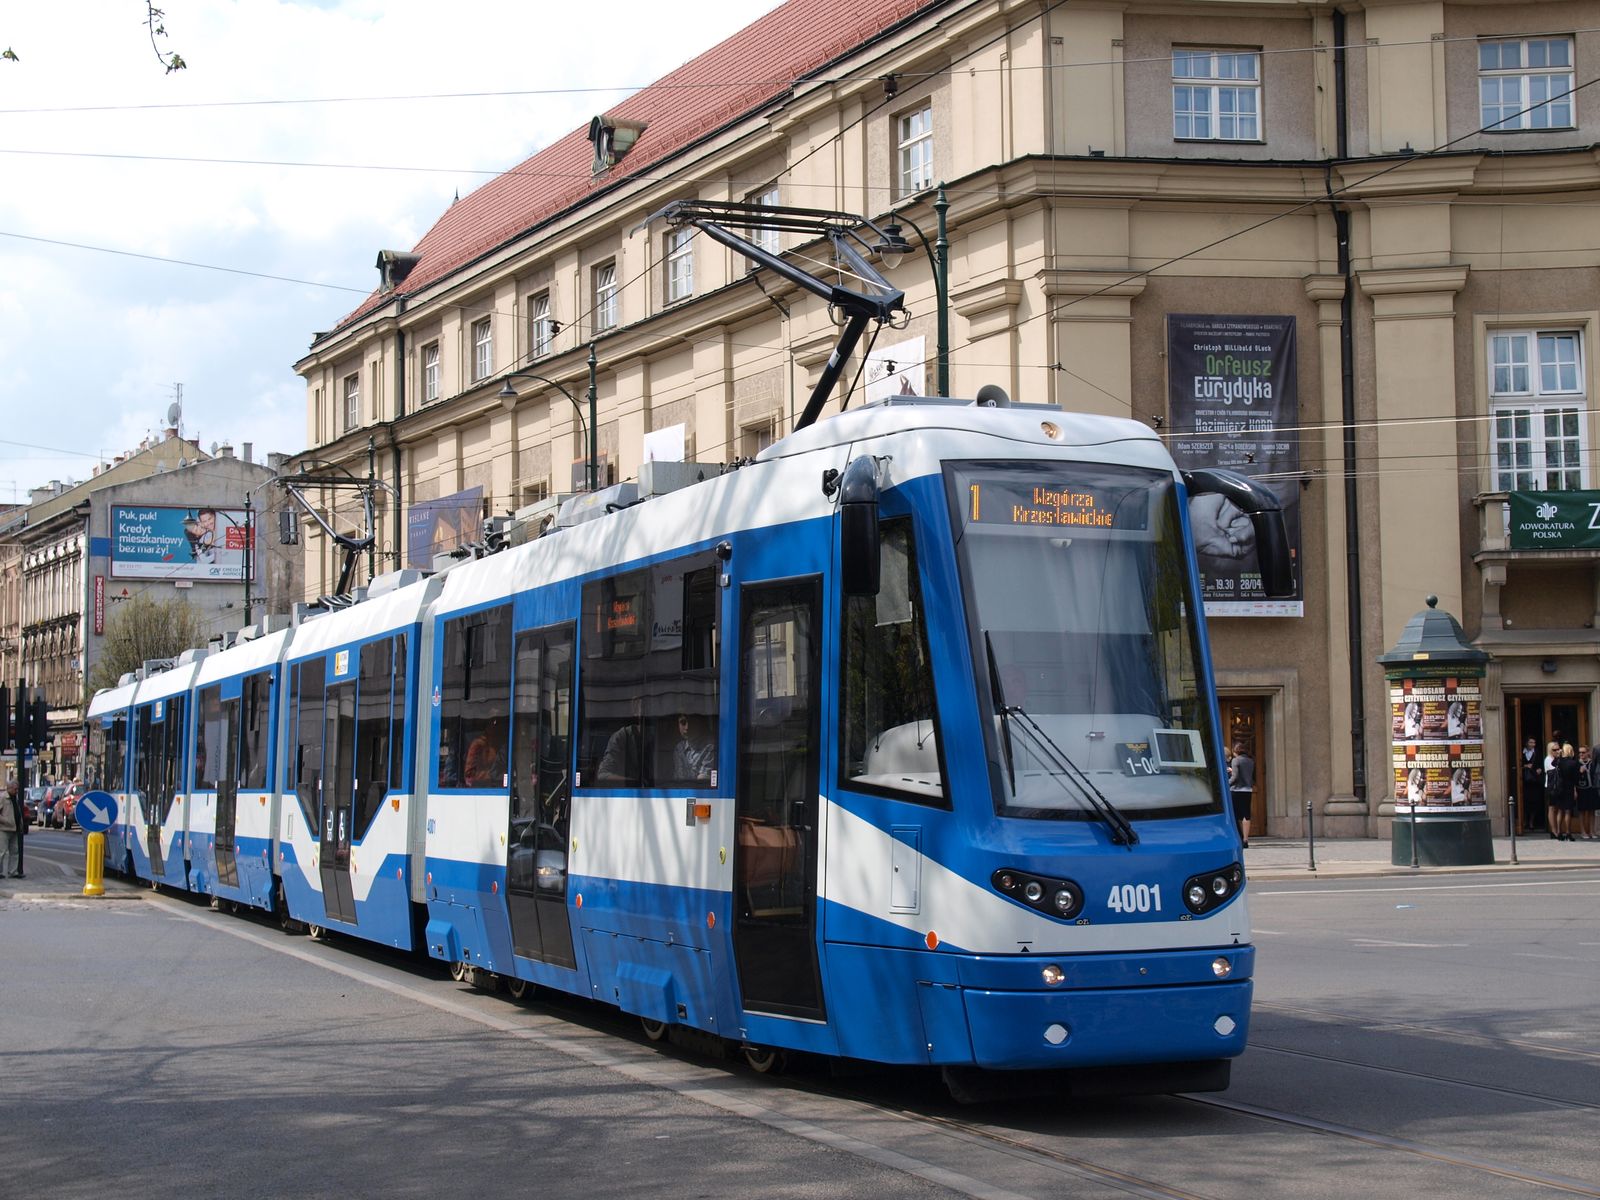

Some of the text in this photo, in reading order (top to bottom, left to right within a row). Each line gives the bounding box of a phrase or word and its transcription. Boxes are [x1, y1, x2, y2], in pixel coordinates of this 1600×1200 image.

[1206, 355, 1272, 376] Orfeusz
[970, 484, 981, 521] 1
[1033, 487, 1093, 507] Wzgórza
[119, 510, 157, 522] Puk, puk!
[1013, 505, 1112, 526] Krzesławickie
[119, 523, 152, 536] Kredyt
[118, 543, 169, 557] bez marży!
[119, 534, 184, 547] mieszkaniowy
[1107, 884, 1161, 913] 4001
